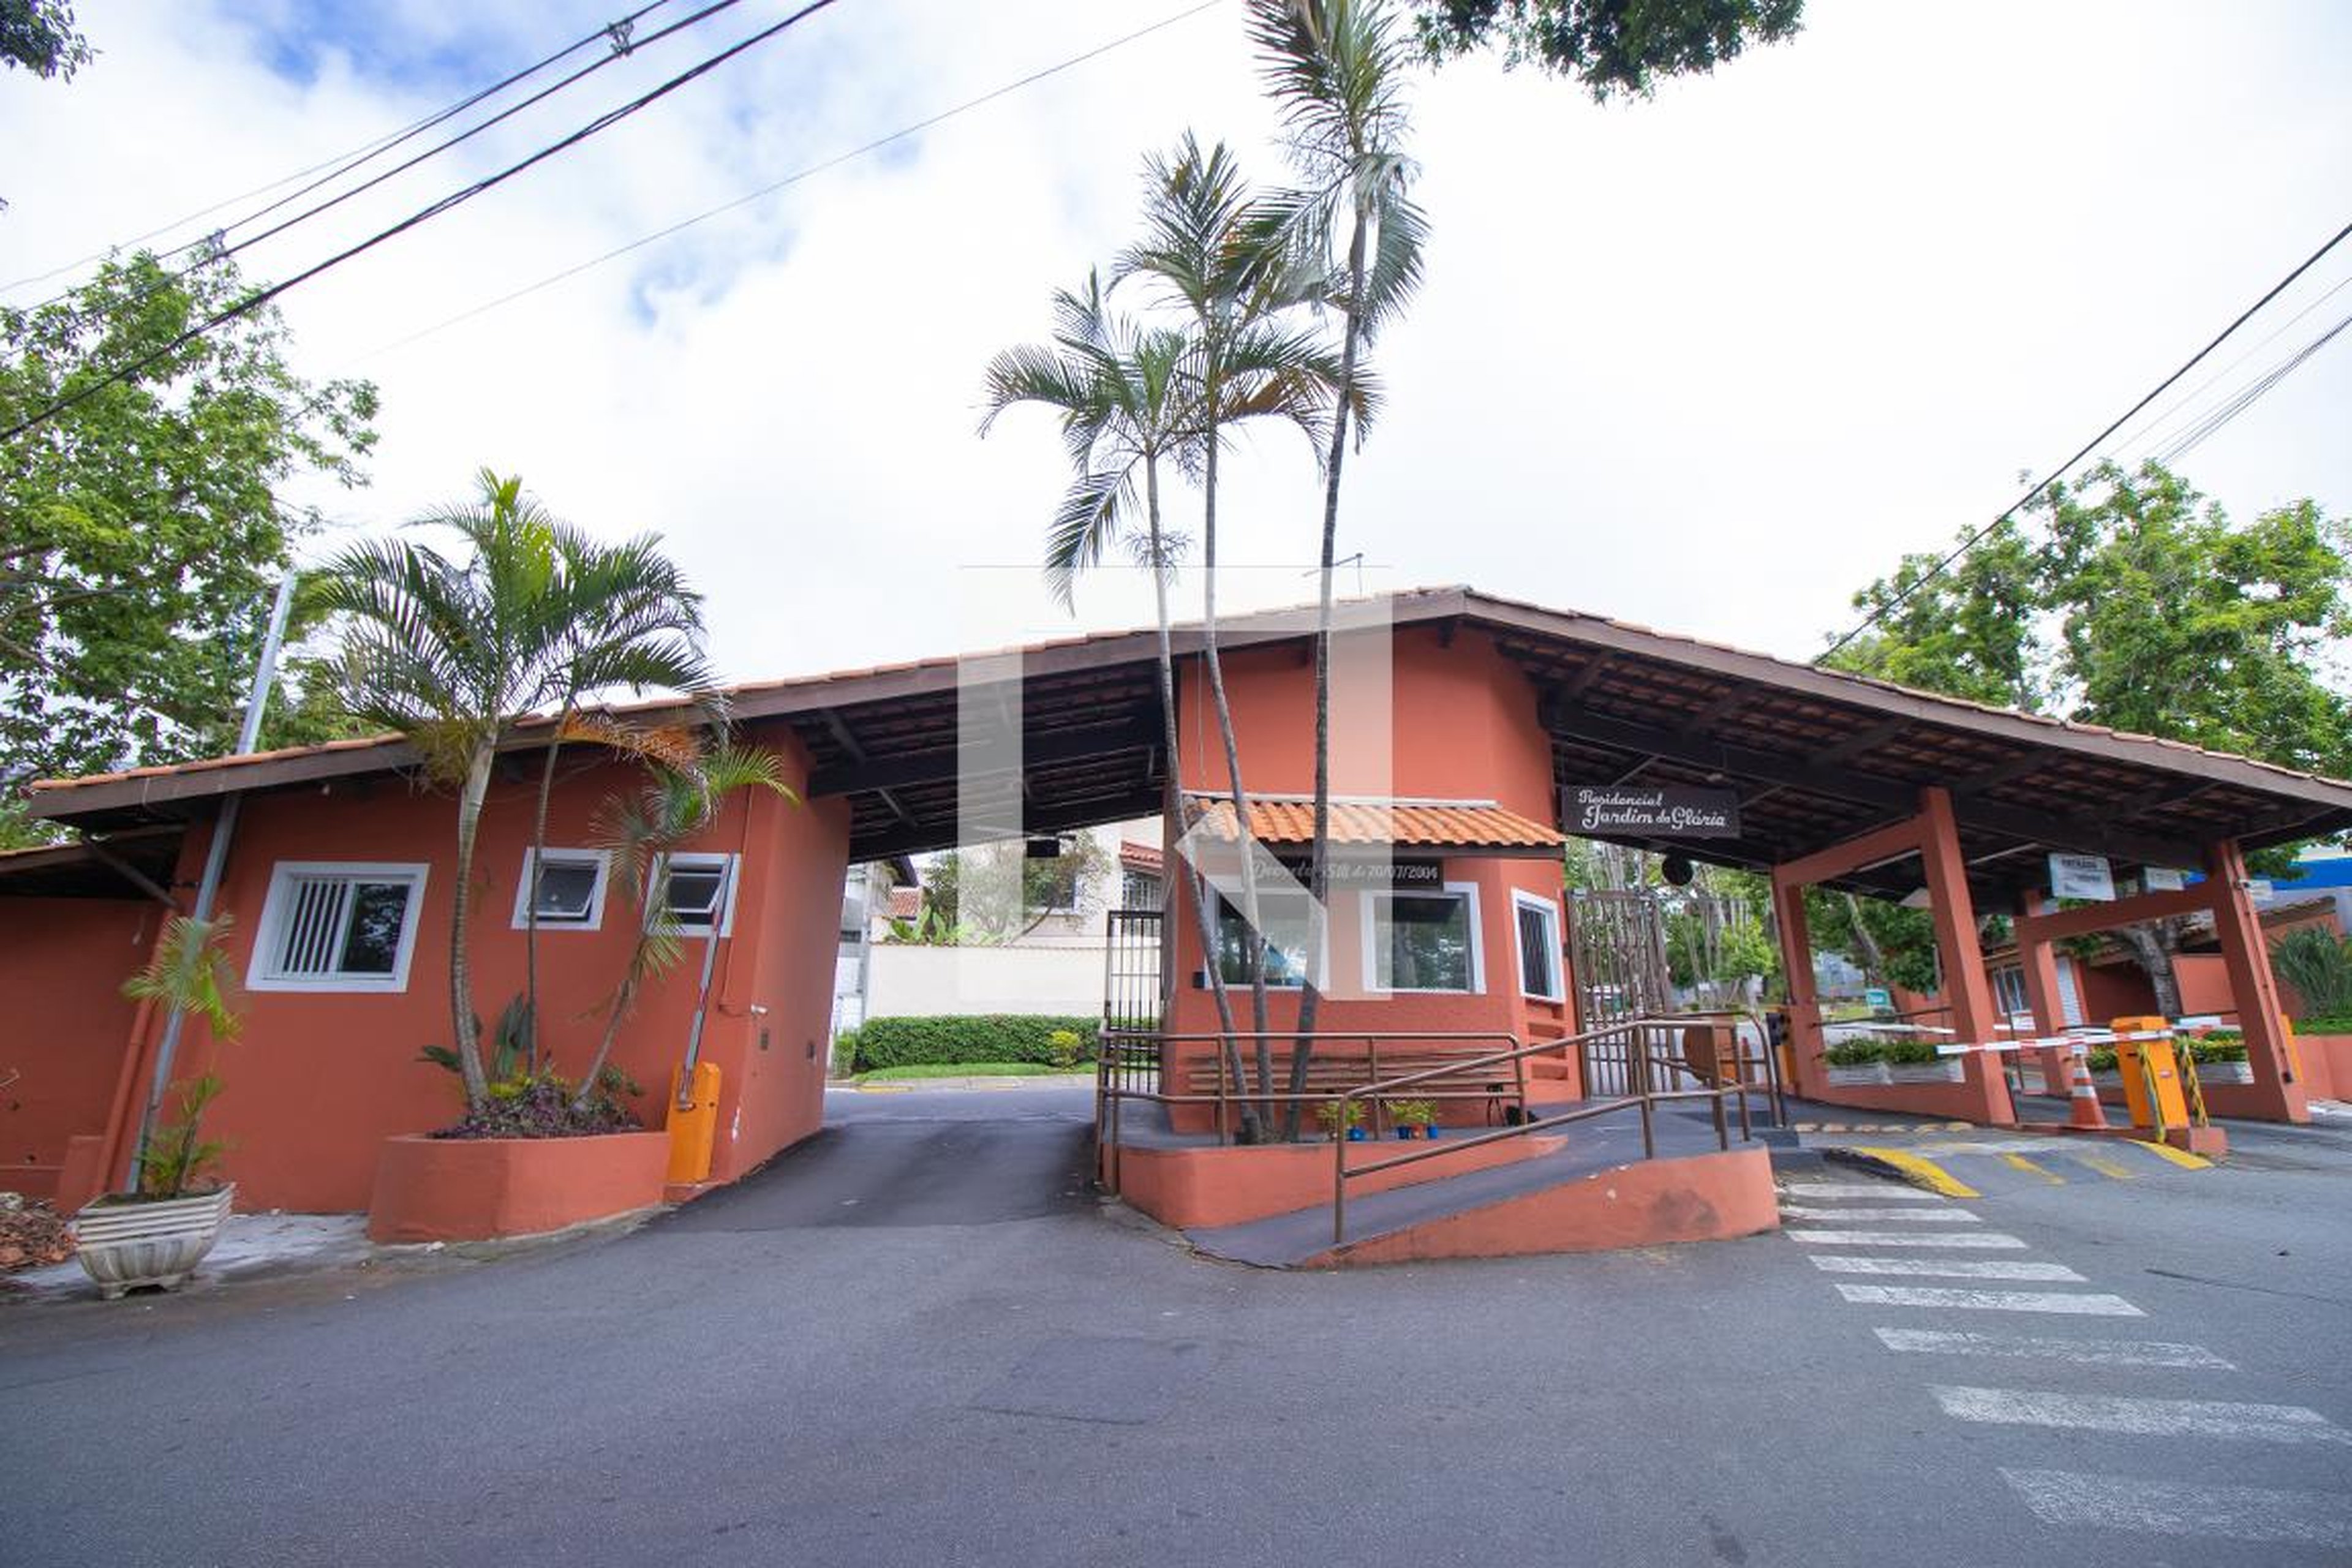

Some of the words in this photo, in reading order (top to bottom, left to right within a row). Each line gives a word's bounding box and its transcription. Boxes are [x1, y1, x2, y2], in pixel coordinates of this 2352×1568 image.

[1578, 789, 1663, 806] Residencial
[1581, 804, 1654, 829] Jardim
[1655, 809, 1671, 824] da
[1671, 805, 1725, 830] Glória
